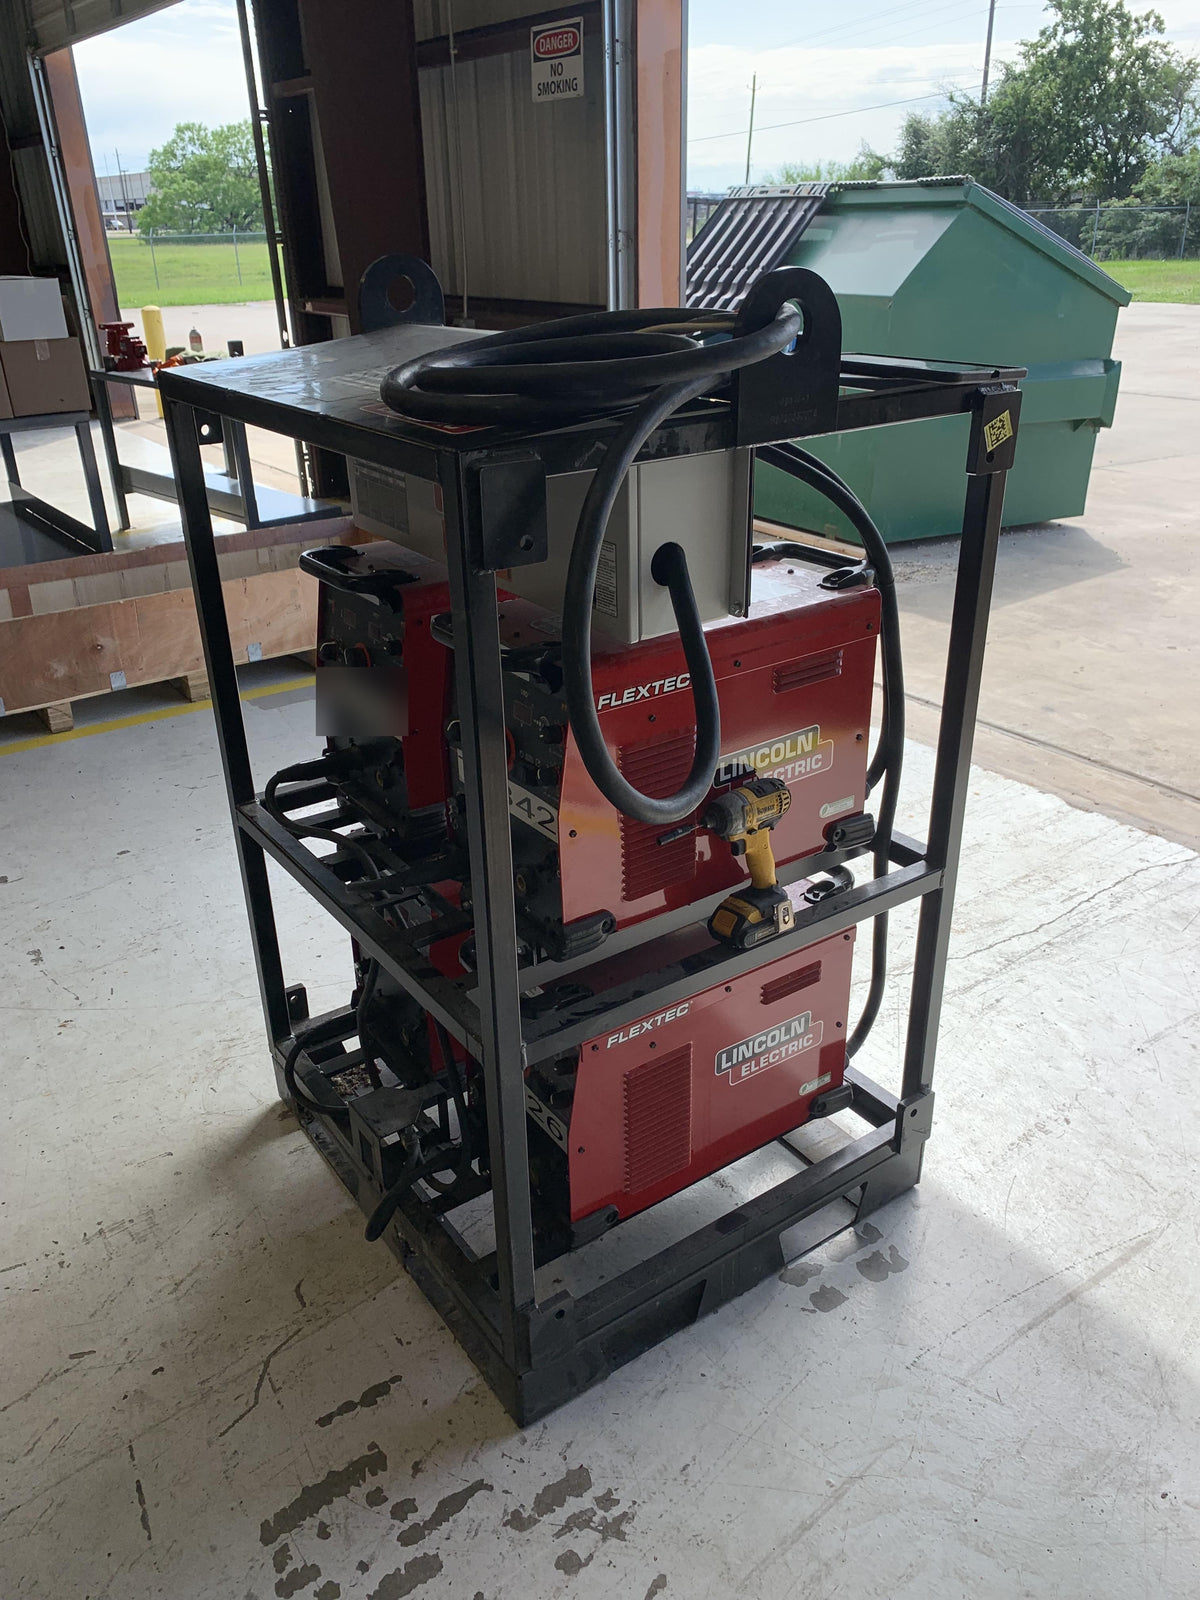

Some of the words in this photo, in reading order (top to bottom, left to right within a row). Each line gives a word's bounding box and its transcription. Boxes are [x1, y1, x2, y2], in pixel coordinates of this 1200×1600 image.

[540, 33, 574, 52] DANGER
[537, 77, 578, 97] SMOKING
[550, 62, 564, 77] NO
[597, 673, 691, 710] FLEXTEC
[719, 731, 813, 782] LINCOLN
[743, 753, 823, 785] CTRIC
[606, 1002, 689, 1048] FLEXTEC
[720, 1016, 805, 1070] LINCOLN
[740, 1033, 814, 1077] ELECTRIC
